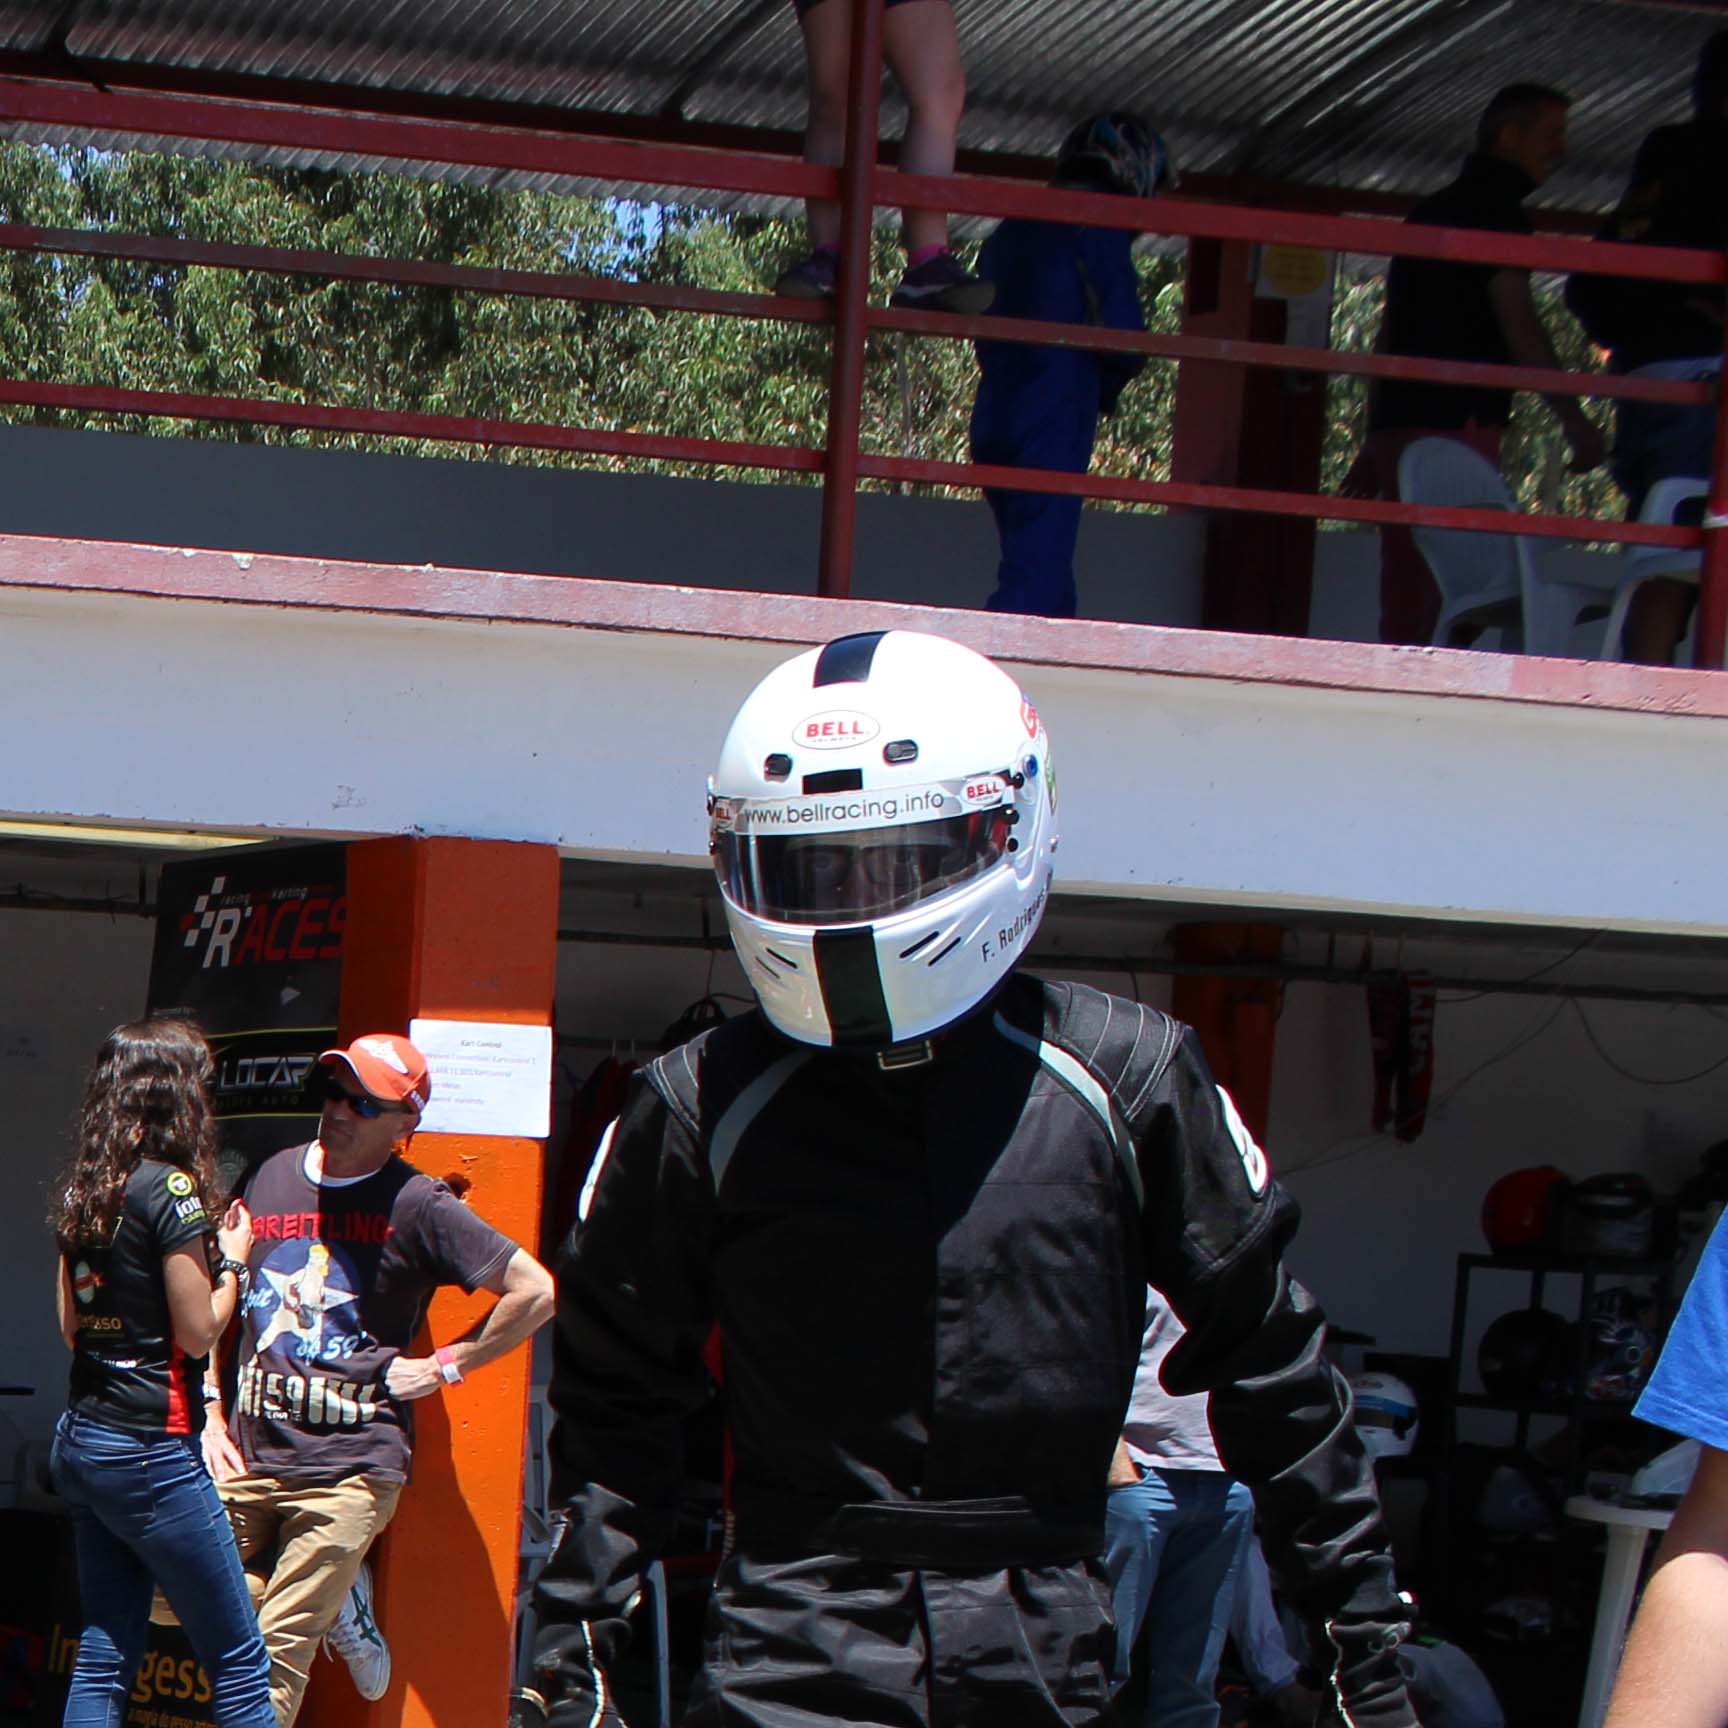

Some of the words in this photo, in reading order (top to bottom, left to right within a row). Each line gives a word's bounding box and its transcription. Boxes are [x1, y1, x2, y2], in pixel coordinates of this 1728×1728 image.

[805, 720, 865, 738] BELL
[966, 783, 1000, 800] BELL
[744, 790, 945, 824] www.bellracing.info
[982, 941, 995, 963] F.
[220, 1056, 315, 1089] LOCAR
